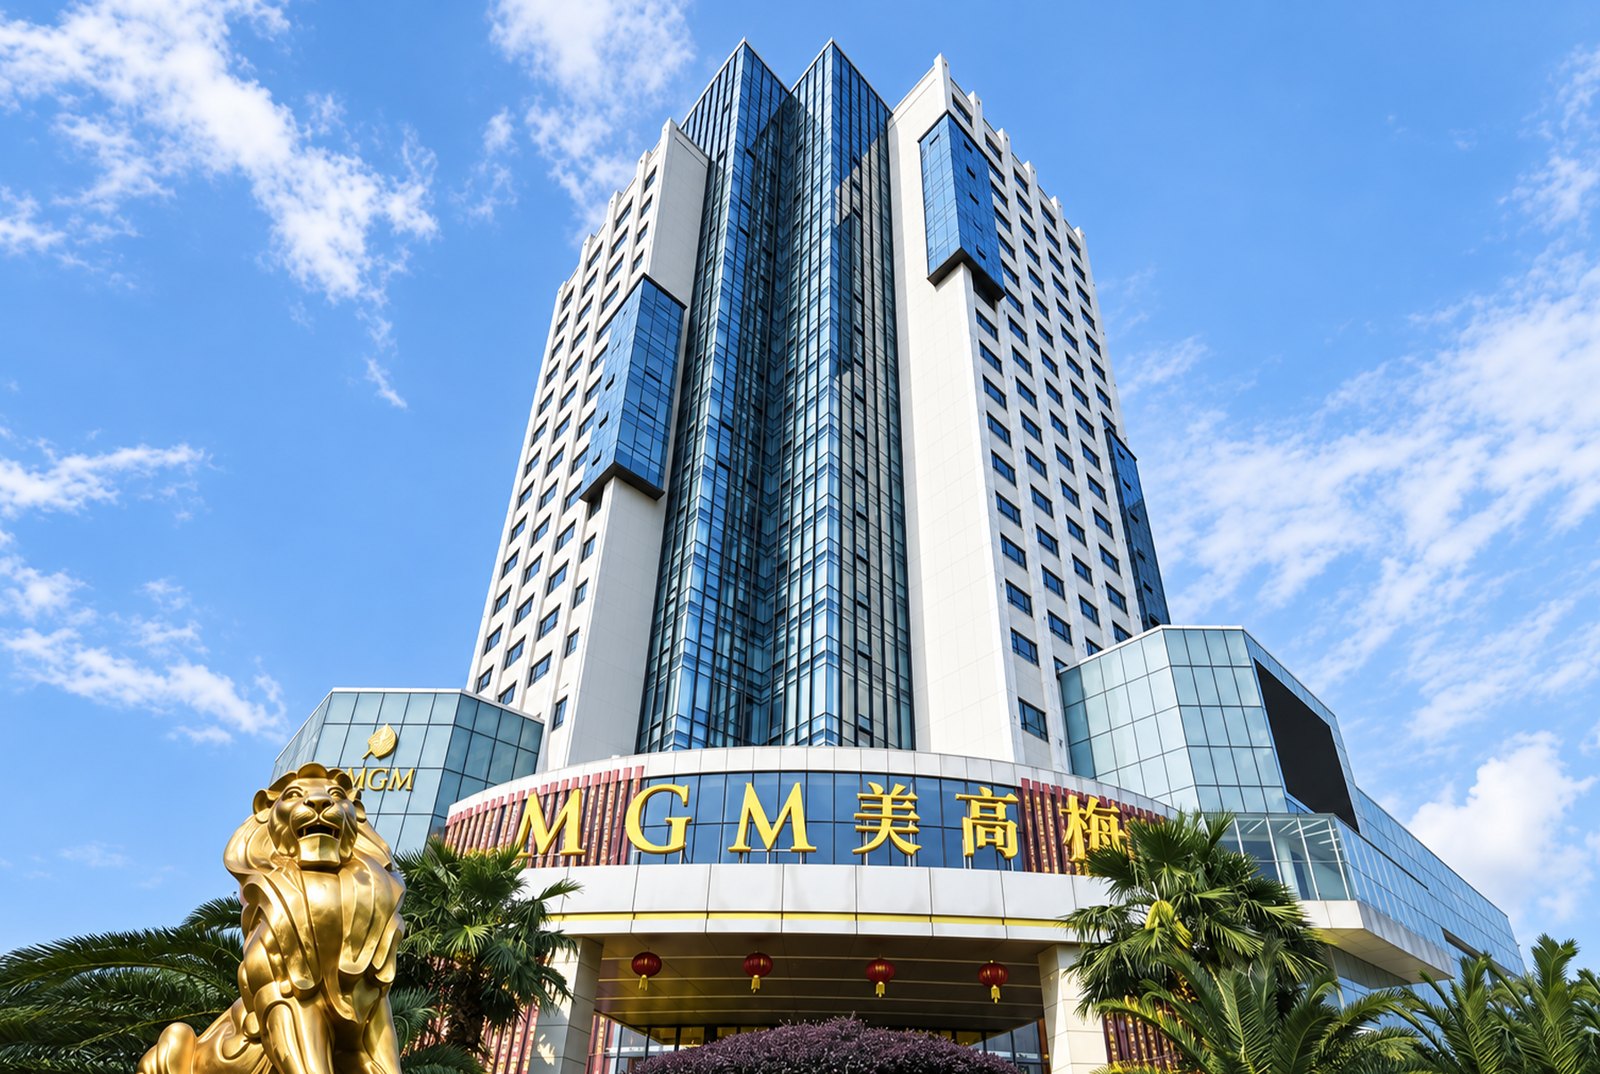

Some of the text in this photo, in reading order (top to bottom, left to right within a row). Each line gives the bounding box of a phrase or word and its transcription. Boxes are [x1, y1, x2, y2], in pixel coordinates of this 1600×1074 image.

[348, 767, 416, 791] MGM
[516, 781, 1127, 861] MGM 美高梅
